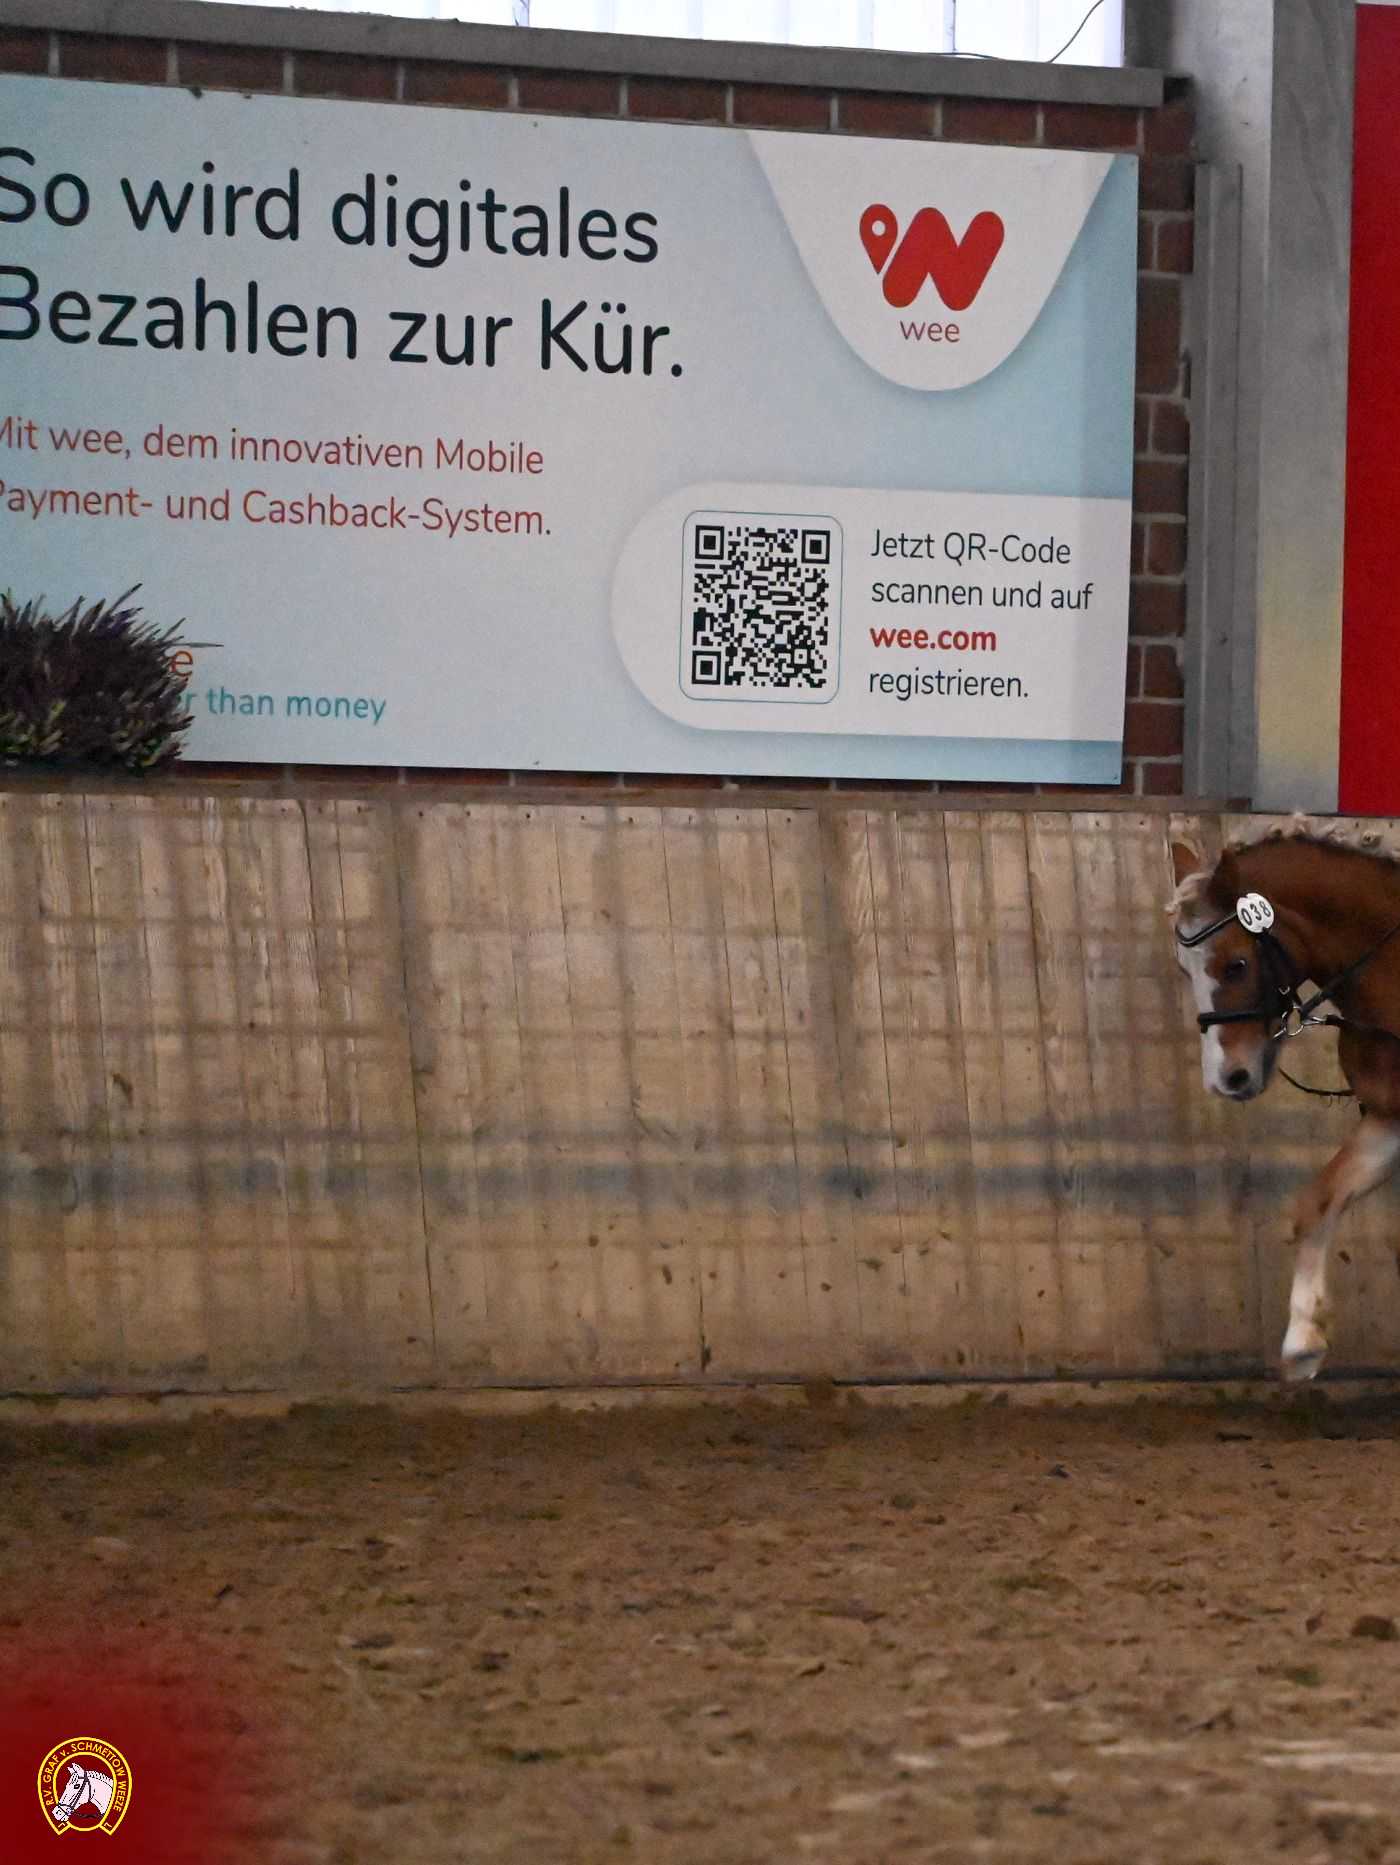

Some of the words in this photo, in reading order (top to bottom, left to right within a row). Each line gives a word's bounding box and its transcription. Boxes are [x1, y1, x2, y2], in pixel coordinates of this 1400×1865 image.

[0, 147, 90, 226] So
[120, 162, 300, 241] wird
[332, 173, 659, 268] digitales
[0, 265, 358, 360] Bezahlen
[389, 311, 513, 368] zur
[541, 299, 684, 378] Kür.
[899, 320, 960, 343] wee
[48, 427, 131, 460] wee,
[144, 423, 218, 459] dem
[231, 428, 423, 469] innovativen
[436, 438, 544, 475] Mobile
[0, 479, 153, 521] ayment-
[166, 489, 230, 522] und
[242, 490, 551, 539] Cashback-System.
[870, 529, 935, 560] Jetzt
[943, 531, 1071, 566] QR-Code
[871, 581, 983, 606] scannen
[992, 581, 1042, 609] und
[1050, 583, 1094, 610] auf
[869, 627, 998, 652] wee.com
[868, 666, 1030, 701] registrieren.
[206, 686, 274, 716] than
[286, 695, 387, 726] money
[1240, 901, 1271, 926] 038
